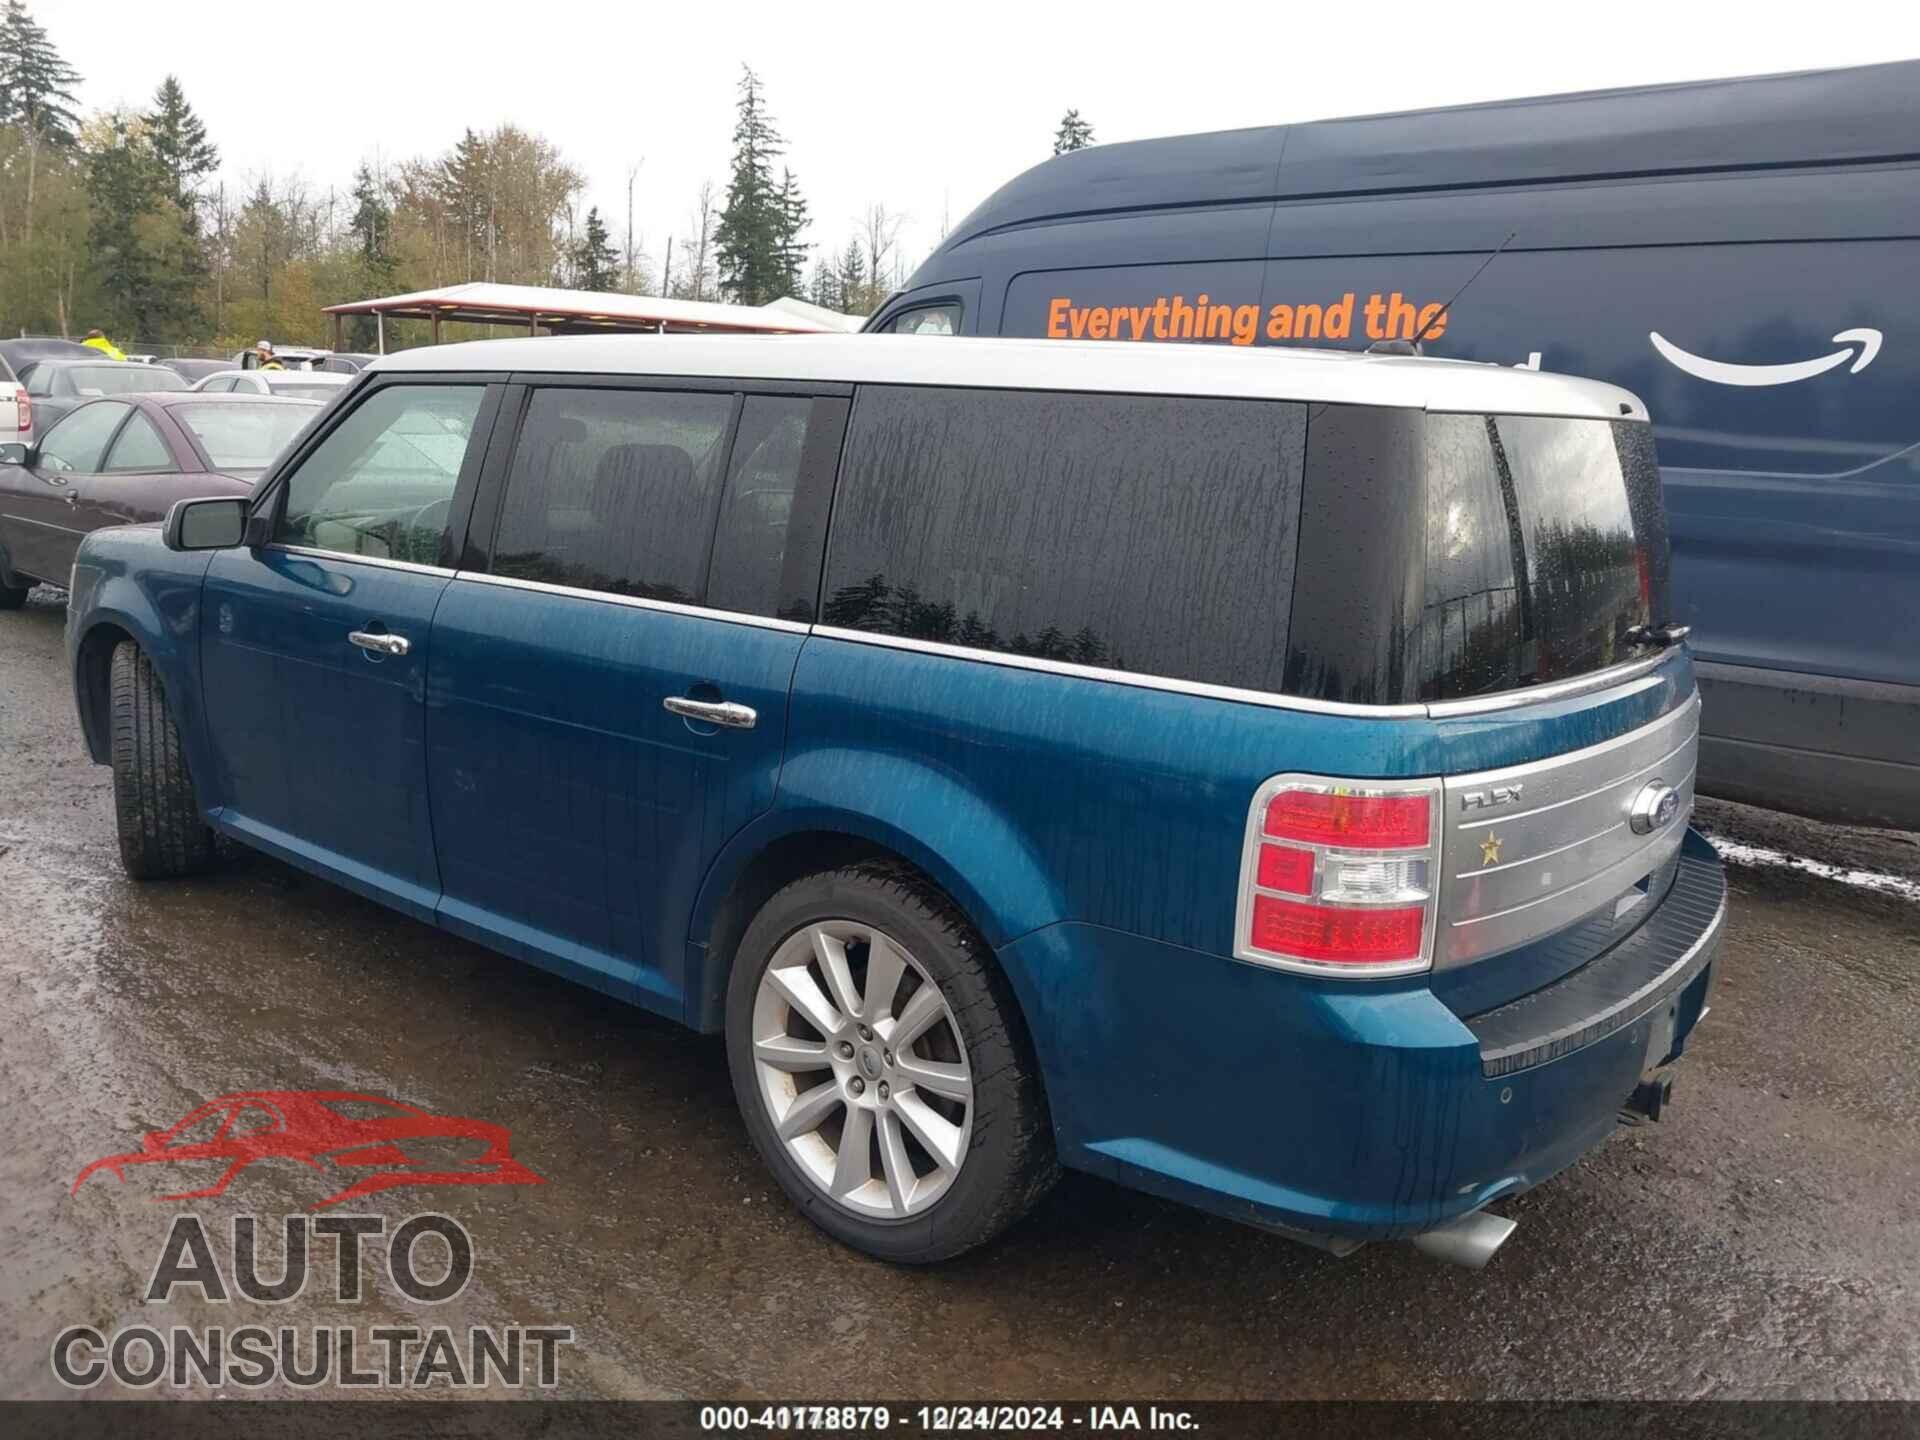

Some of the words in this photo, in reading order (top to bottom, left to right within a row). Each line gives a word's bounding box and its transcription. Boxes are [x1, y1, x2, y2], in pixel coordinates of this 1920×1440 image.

[1048, 294, 1261, 345] Everything
[1267, 293, 1354, 339] and
[1364, 293, 1448, 340] the
[1461, 784, 1524, 811] FLEX
